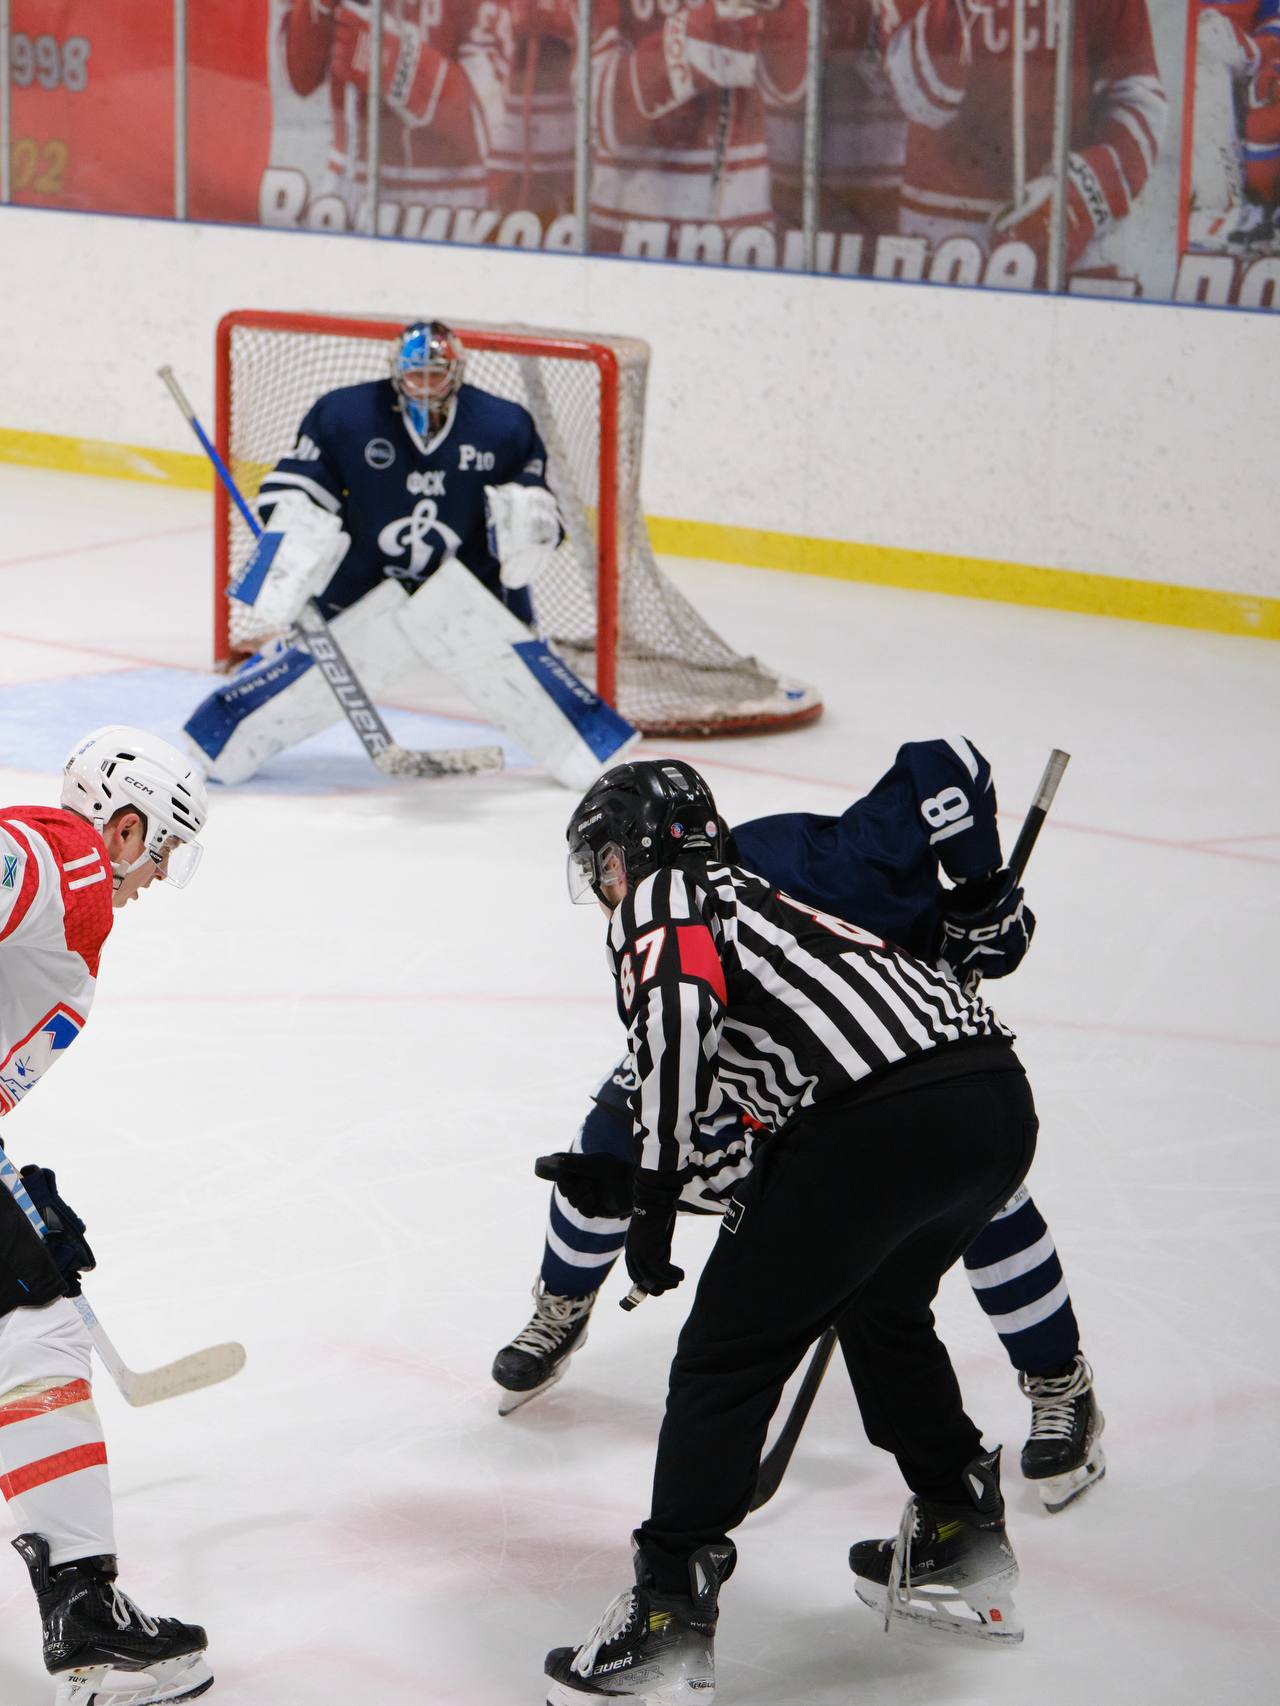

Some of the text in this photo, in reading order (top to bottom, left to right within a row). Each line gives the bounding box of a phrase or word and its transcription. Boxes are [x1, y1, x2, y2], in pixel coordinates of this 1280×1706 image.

[406, 469, 447, 498] ФСК
[309, 636, 389, 757] BAUER
[124, 776, 154, 796] CCM
[577, 812, 603, 832] BAUER
[921, 786, 974, 845] 18
[62, 846, 107, 891] 11
[944, 900, 1024, 942] CCM
[593, 1656, 633, 1676] AUER
